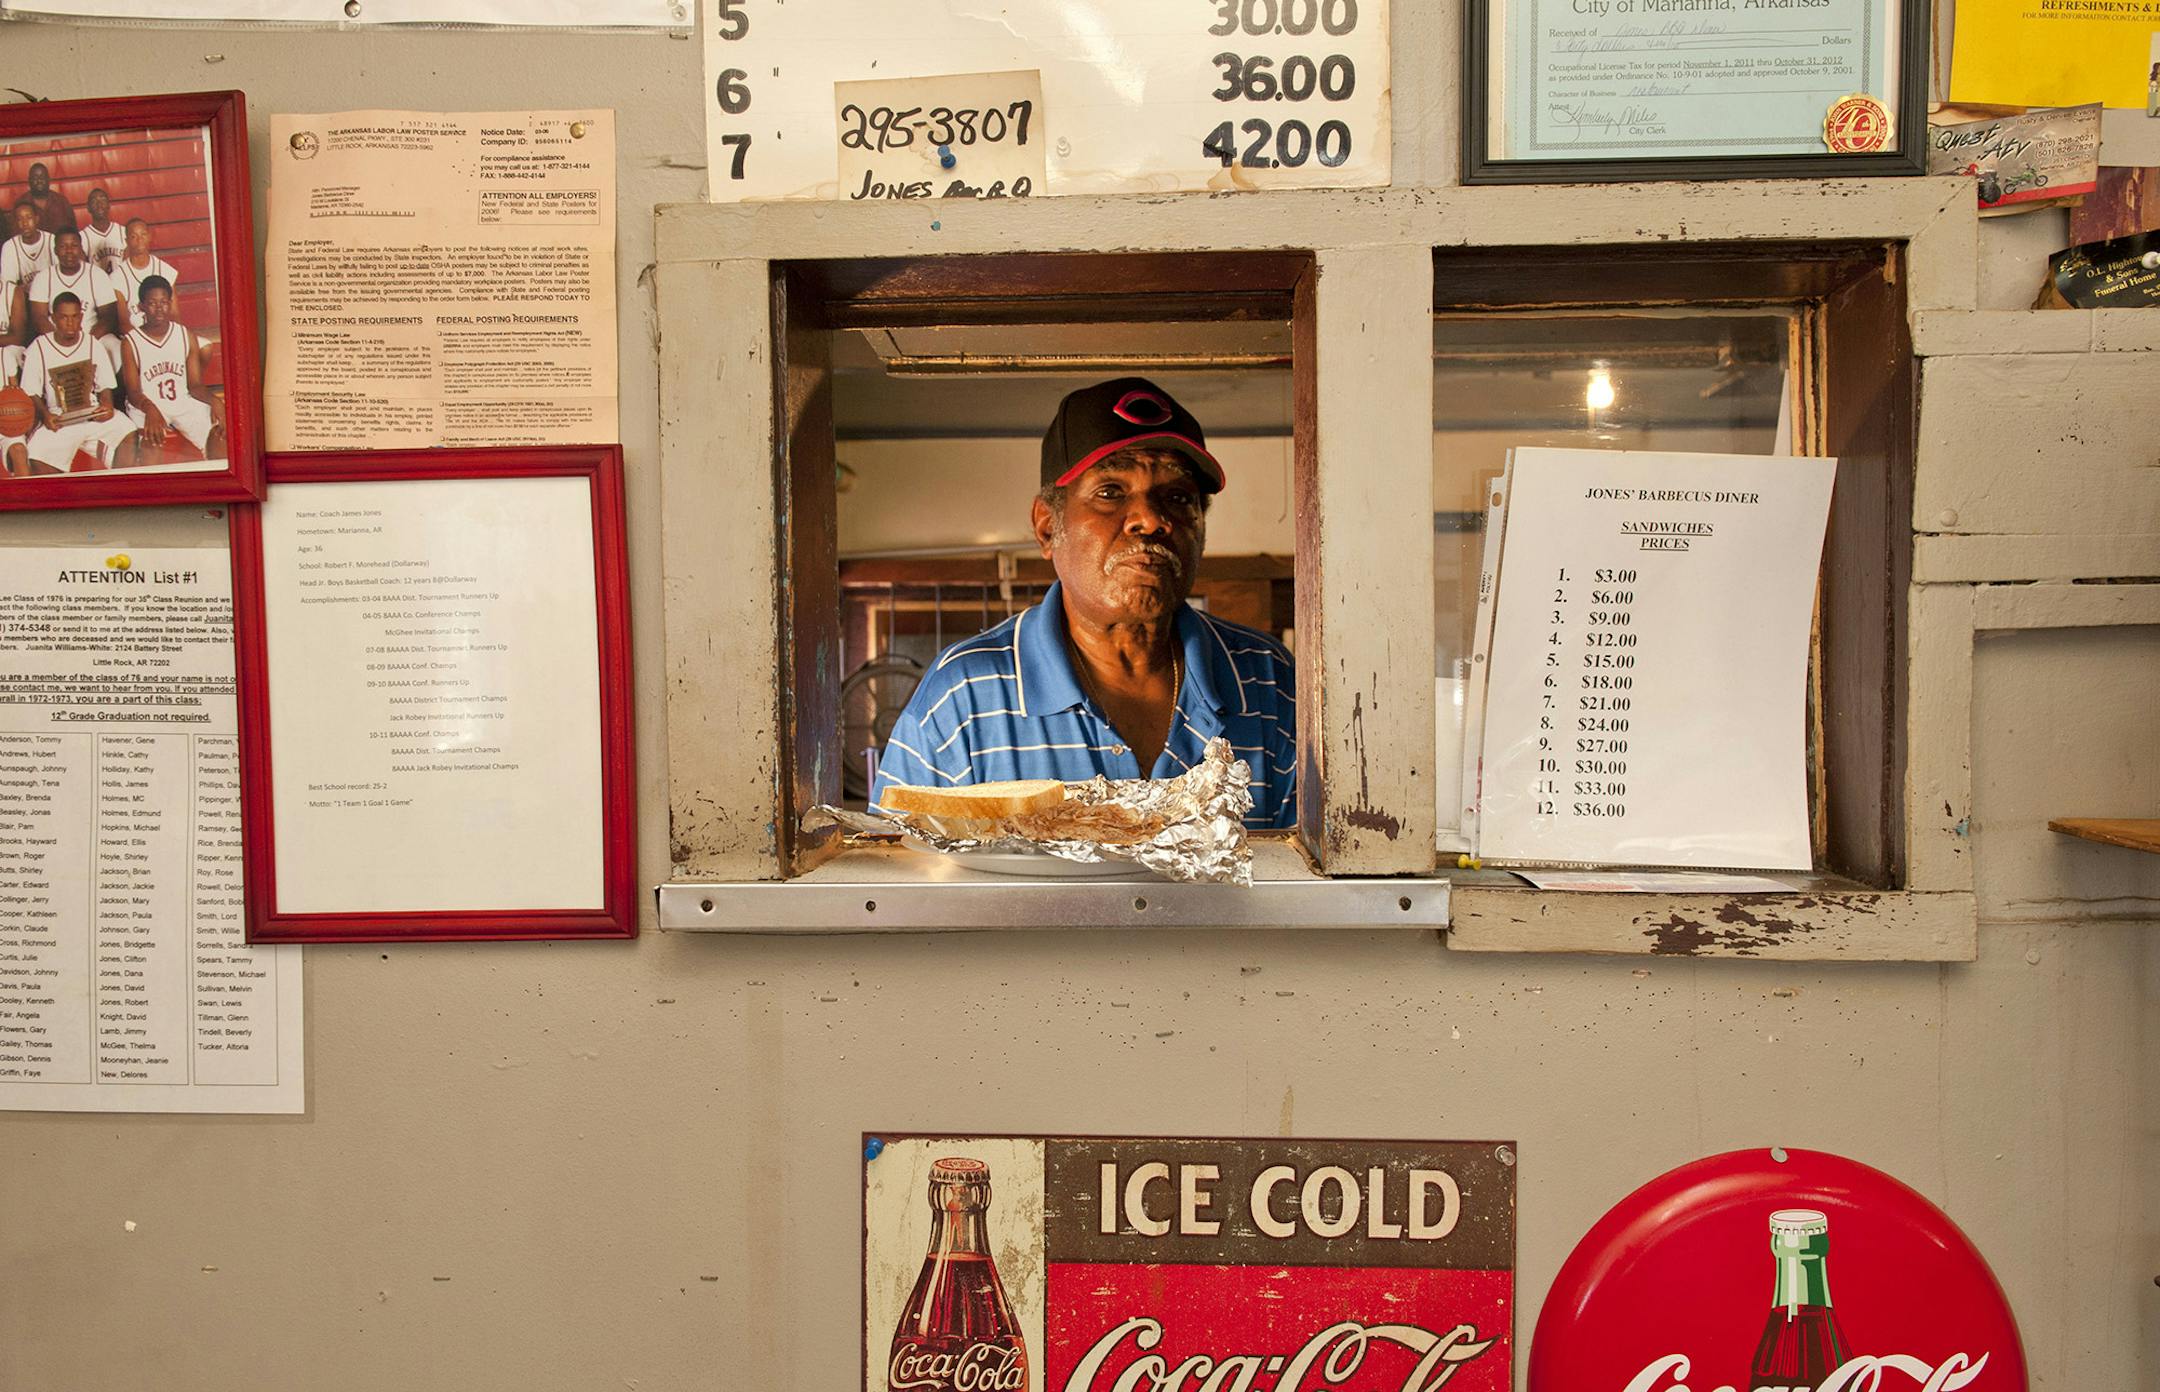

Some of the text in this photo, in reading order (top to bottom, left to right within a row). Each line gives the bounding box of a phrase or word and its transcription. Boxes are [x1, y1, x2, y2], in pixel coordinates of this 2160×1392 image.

[2042, 1, 2151, 12] REFRESHMENTS &
[718, 0, 749, 41] 5
[1208, 0, 1358, 36] 30.00
[1549, 28, 1597, 37] Received of
[1822, 36, 1851, 46] Dollars
[1549, 63, 1596, 72] Occupational
[1657, 60, 1681, 71] period
[1683, 58, 1721, 68] November
[1724, 59, 1732, 68] 1,
[1734, 58, 1754, 66] 2011
[1757, 58, 1772, 66] thru
[1774, 57, 1805, 65] October
[1807, 57, 1820, 65] 31,
[1823, 56, 1843, 64] 2012
[1212, 52, 1355, 102] 36.00
[716, 68, 751, 114] 6
[841, 100, 1032, 153] 295-3807
[1629, 126, 1666, 135] City Clerk
[481, 138, 513, 147] Company
[1203, 118, 1351, 168] 42.00
[493, 154, 529, 163] compliance
[721, 134, 751, 180] 7
[851, 170, 932, 199] JONES
[2106, 268, 2138, 283] & Sons
[2094, 281, 2128, 297] Funeral
[2129, 272, 2157, 286] Home
[291, 317, 423, 325] STATE POSTING REQUIREMENTS
[436, 316, 473, 324] FEDERAL
[476, 316, 512, 324] POSTING
[144, 361, 185, 382] CARDINALS
[158, 378, 177, 401] 13
[1638, 490, 1712, 503] BARBECUS
[1715, 492, 1759, 505] DINER
[338, 527, 370, 535] Marianna,
[1621, 521, 1713, 534] SANDWICHES
[1640, 537, 1689, 549] PRICES
[58, 571, 198, 583] ATTENTION List #1
[1559, 568, 1637, 583] 1. $3.00
[1554, 589, 1634, 604] 2. $6.00
[1551, 611, 1631, 626] 3. $9.00
[1549, 632, 1637, 647] 4. $12.00
[1547, 653, 1635, 669] 5. $15.00
[1544, 674, 1633, 690] 6. $18.00
[1544, 695, 1631, 711] 7. $21.00
[97, 712, 151, 720] Graduation
[171, 712, 209, 722] required.
[1541, 716, 1629, 732] 8. $24.00
[102, 737, 133, 745] Havener,
[1540, 738, 1628, 753] 9. $27.00
[102, 751, 148, 760] Hinkle, Cathy
[1539, 759, 1627, 775] 10. $30.00
[1538, 781, 1626, 796] 11. $33.00
[1537, 802, 1625, 817] 12. $36.00
[99, 926, 150, 935] Johnson, Gary
[197, 956, 252, 965] Spears, Tammy
[197, 971, 236, 979] Stevenson,
[100, 1042, 156, 1050] McGee, Thelma
[1100, 1161, 1461, 1241] ICE COLD
